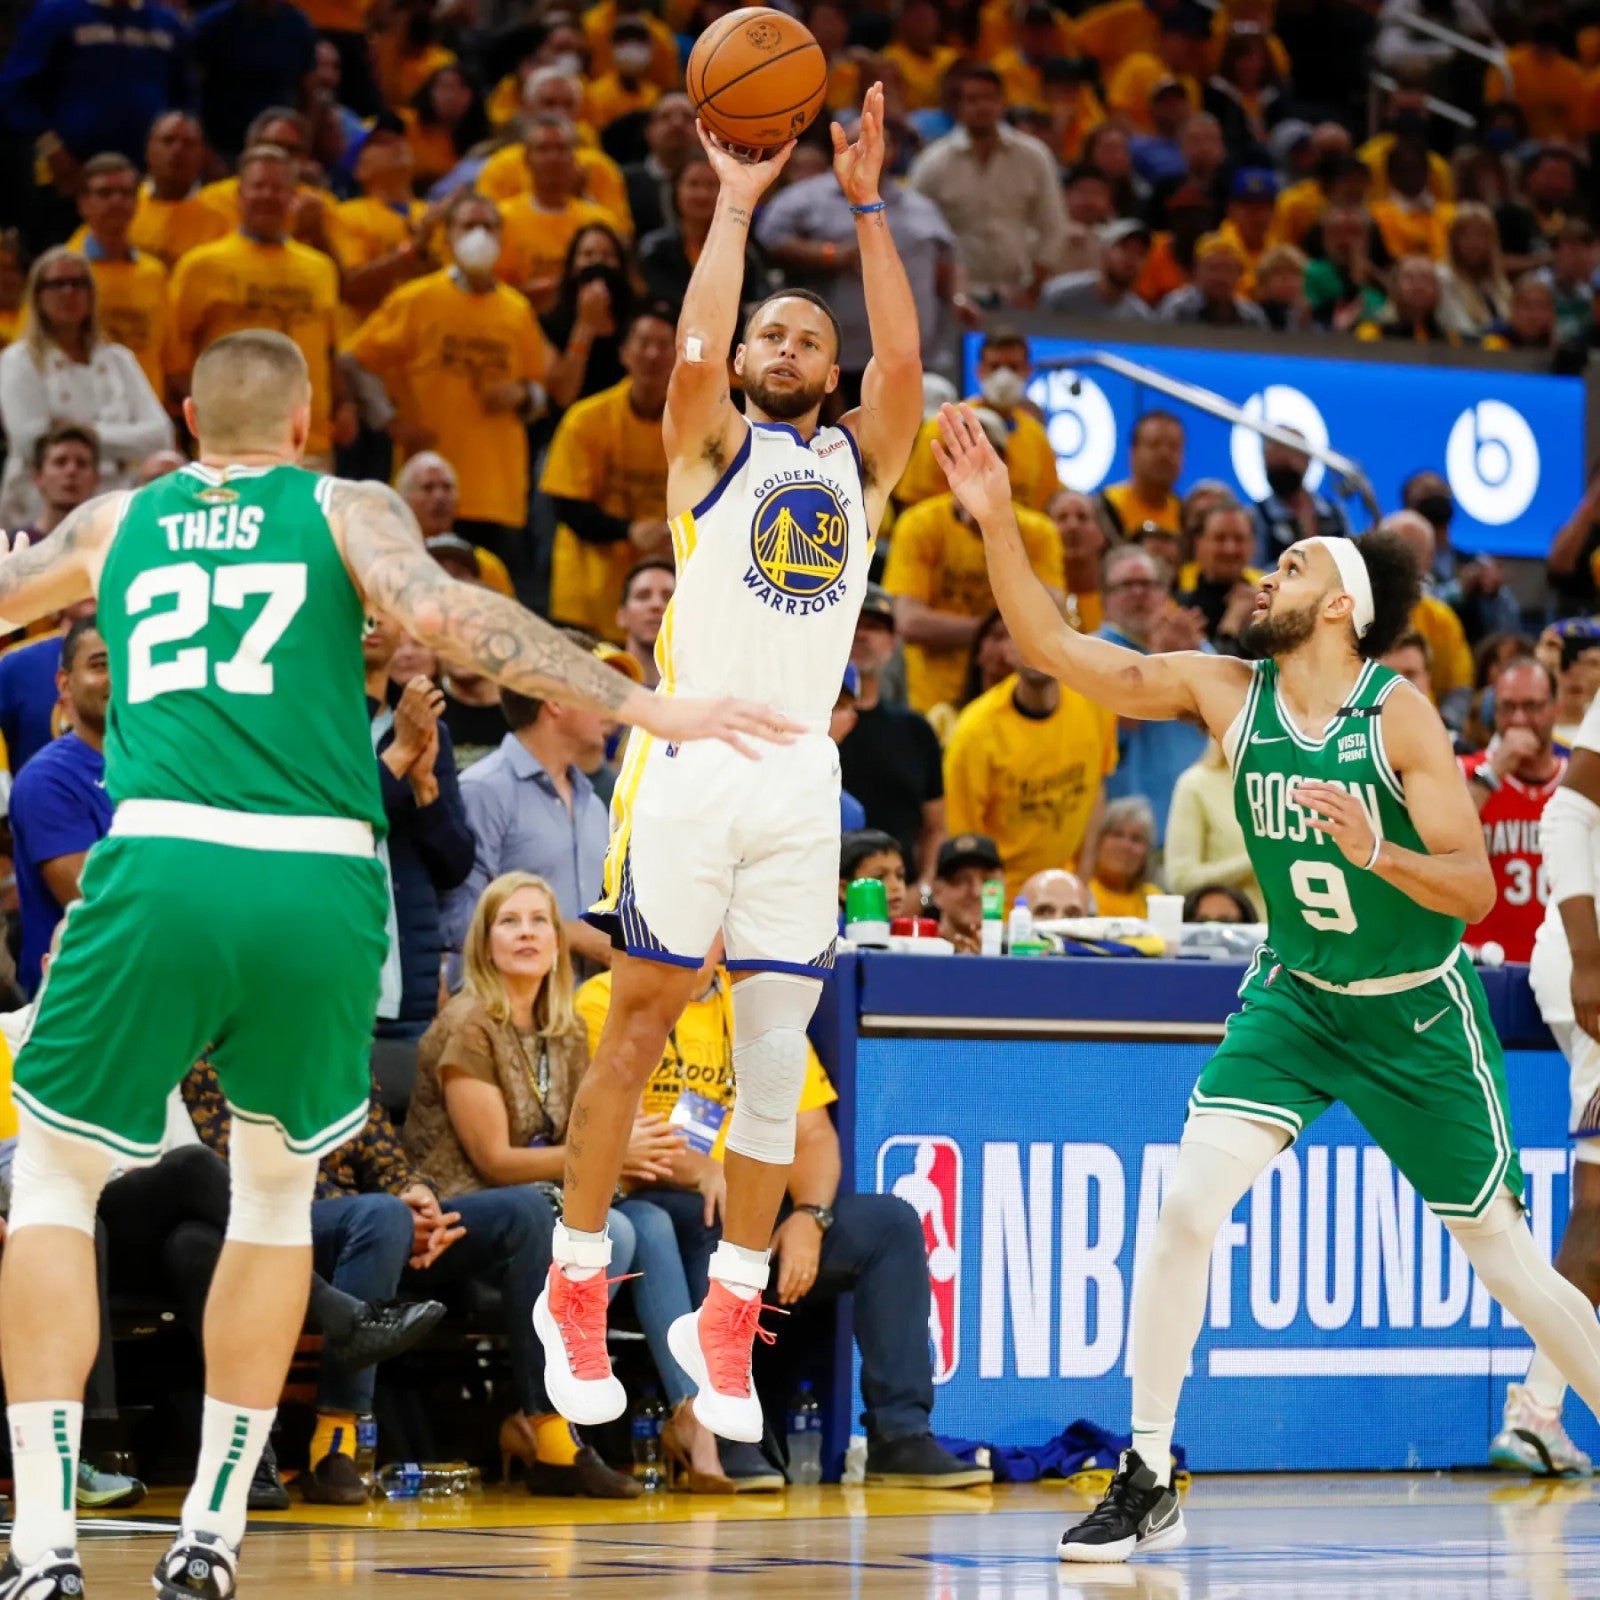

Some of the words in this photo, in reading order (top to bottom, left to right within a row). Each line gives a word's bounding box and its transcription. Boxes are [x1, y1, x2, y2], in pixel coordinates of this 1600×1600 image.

[817, 439, 848, 459] kuten
[754, 469, 815, 499] GOLDEN
[157, 504, 265, 551] THEIS
[813, 511, 843, 547] 30
[743, 565, 848, 616] WARRIORS
[125, 561, 308, 704] 27
[1337, 733, 1367, 752] VISTA
[1338, 747, 1367, 764] PRINT
[1245, 771, 1385, 845] BOSTN
[1289, 859, 1359, 935] 9
